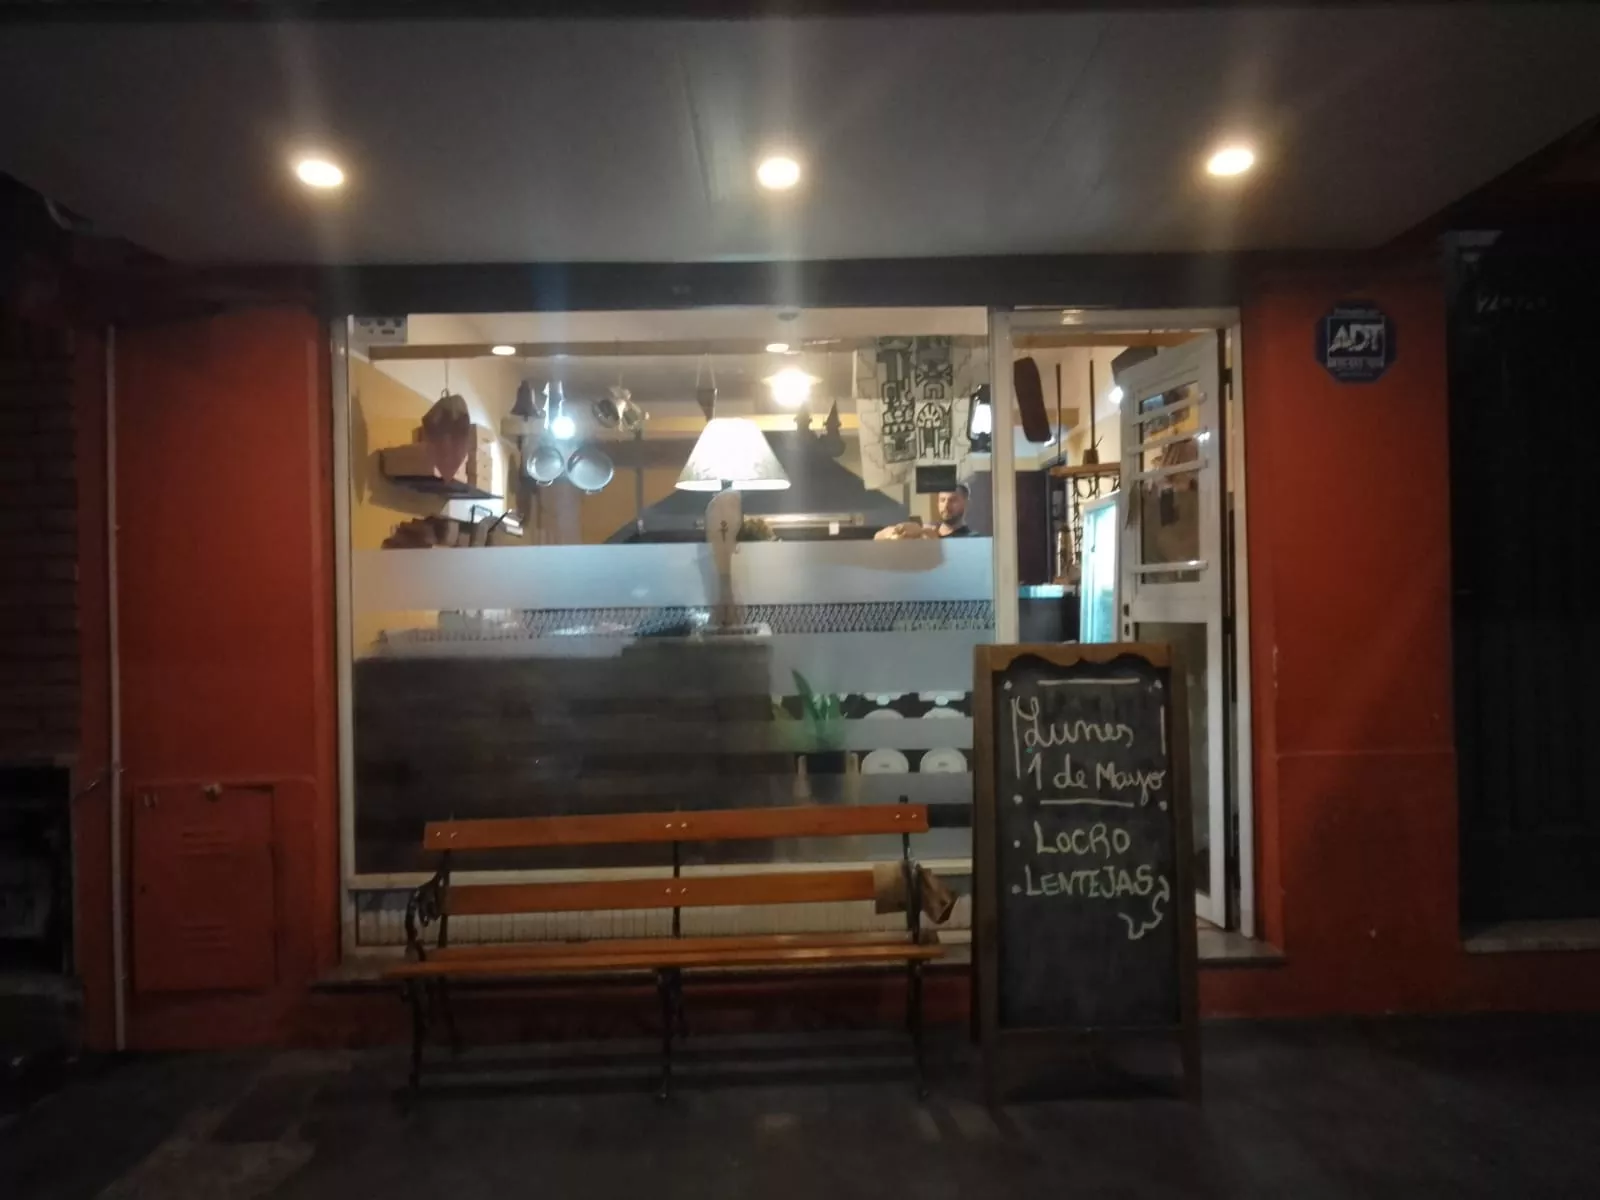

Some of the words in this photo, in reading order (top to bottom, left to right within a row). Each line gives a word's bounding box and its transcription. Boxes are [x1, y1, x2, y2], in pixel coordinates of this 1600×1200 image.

[1328, 323, 1384, 352] ADT
[1016, 697, 1133, 748] Lunes
[1027, 752, 1042, 790] 1
[1053, 754, 1088, 789] de
[1095, 762, 1166, 806] Mayo
[1034, 820, 1131, 859] LOCRO
[1024, 864, 1153, 898] LENTEJAS
